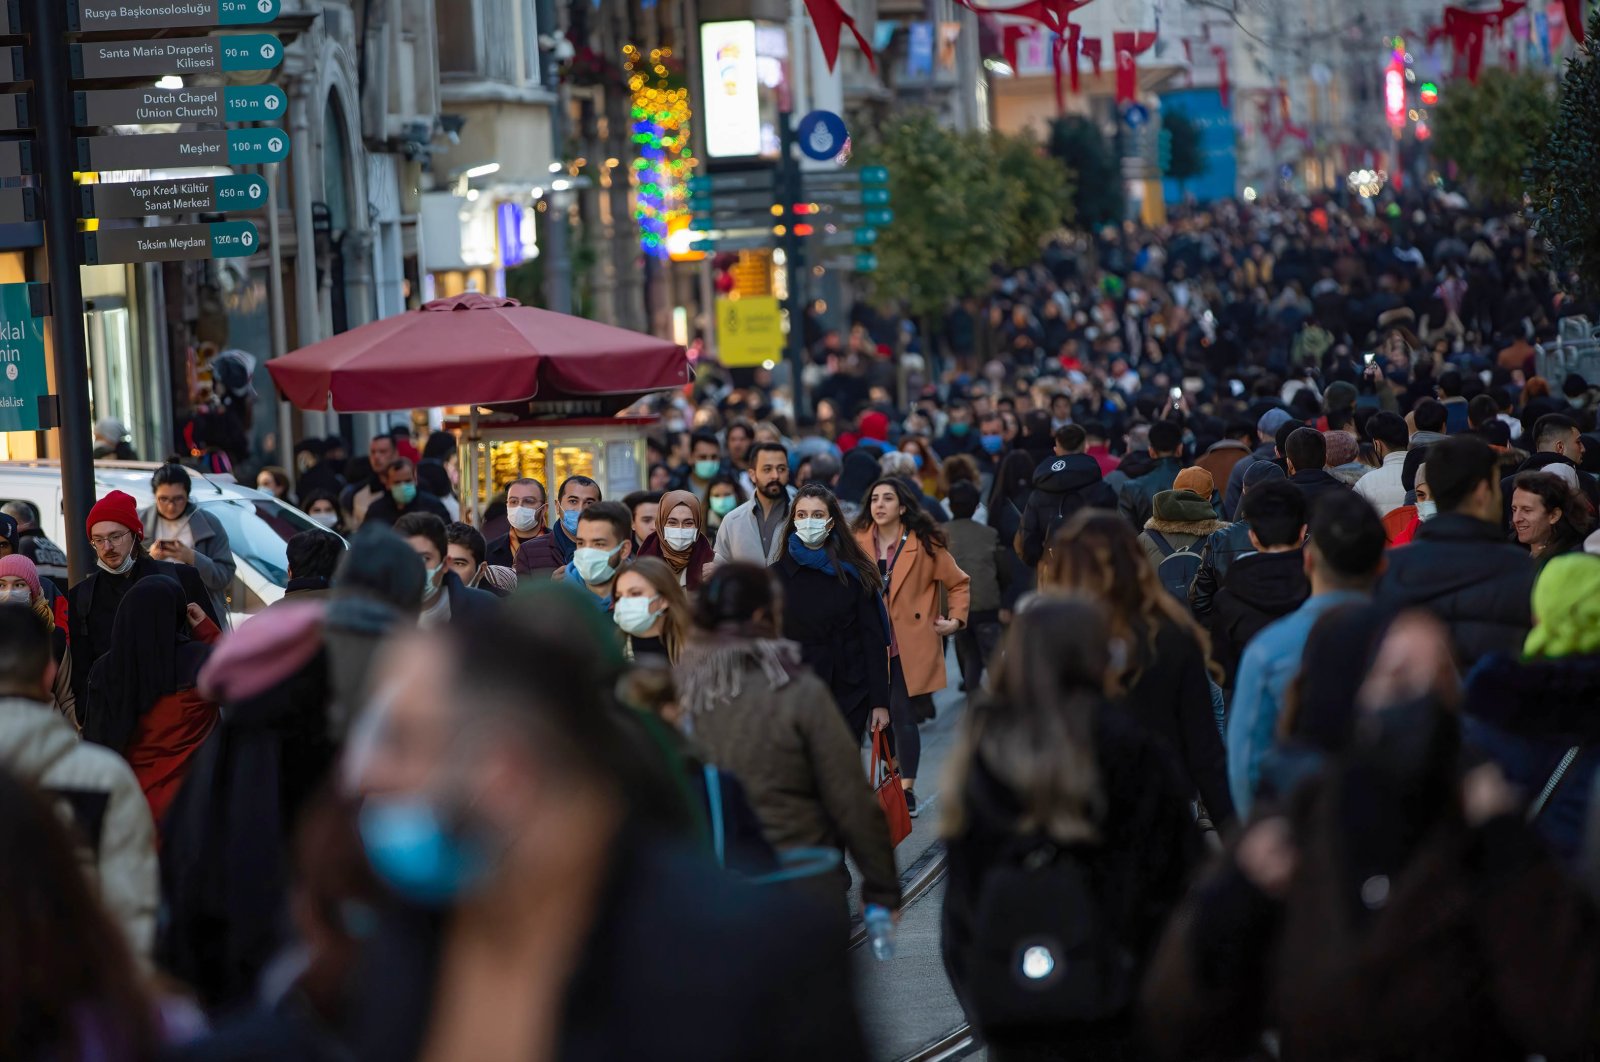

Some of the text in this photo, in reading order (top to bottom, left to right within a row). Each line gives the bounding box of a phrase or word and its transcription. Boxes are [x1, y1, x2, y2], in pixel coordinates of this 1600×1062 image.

[85, 4, 211, 19] Rusya Başkonsolosluğu
[222, 2, 235, 11] 50
[99, 44, 213, 59] Santa Maria Draperis
[225, 48, 237, 57] 90
[176, 57, 215, 69] Kilisesi
[143, 92, 218, 104] Dutch Chapel
[229, 99, 259, 108] 150 m
[136, 106, 218, 119] (Union Church)
[180, 143, 220, 155] Meşher
[232, 142, 262, 151] 100 m
[130, 187, 151, 199] Yapı
[181, 183, 209, 194] Kültür
[219, 190, 235, 198] 450
[145, 197, 210, 211] Sanat Merkezi
[137, 237, 206, 250] Taksim Meydanı
